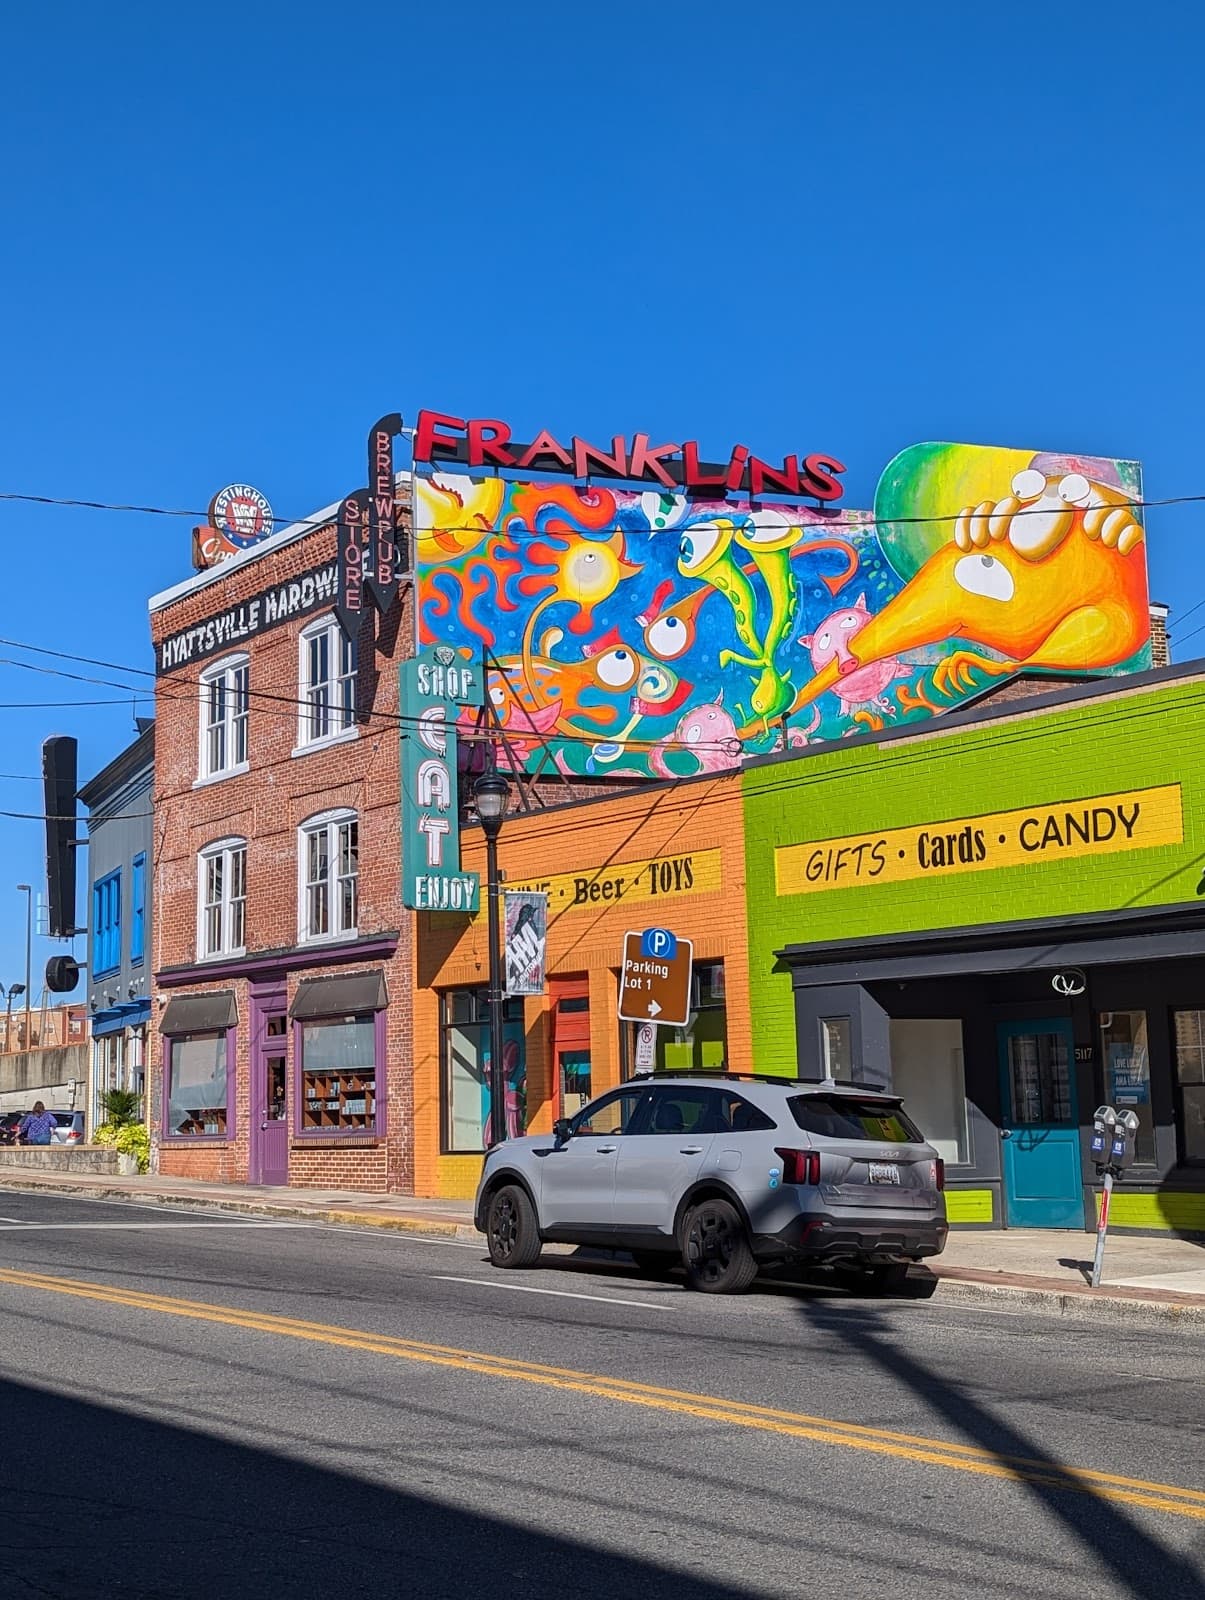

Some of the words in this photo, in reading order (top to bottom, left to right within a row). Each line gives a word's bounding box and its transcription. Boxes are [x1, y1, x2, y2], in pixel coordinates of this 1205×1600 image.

[217, 486, 272, 535] WESTINGHOUSE
[345, 499, 362, 611] STORE
[161, 600, 260, 670] HYATTSVILLE
[417, 663, 474, 699] SHOP
[418, 705, 450, 867] EAT
[805, 839, 886, 882] GIFTS
[918, 826, 986, 869] Cards
[1019, 803, 1140, 852] CANDY
[415, 875, 475, 910] ENJOY
[573, 877, 625, 904] Beer
[649, 857, 694, 895] TOYS
[625, 976, 642, 990] Lot
[646, 979, 652, 991] 1
[626, 959, 669, 980] Parking
[1074, 1047, 1093, 1061] 5117
